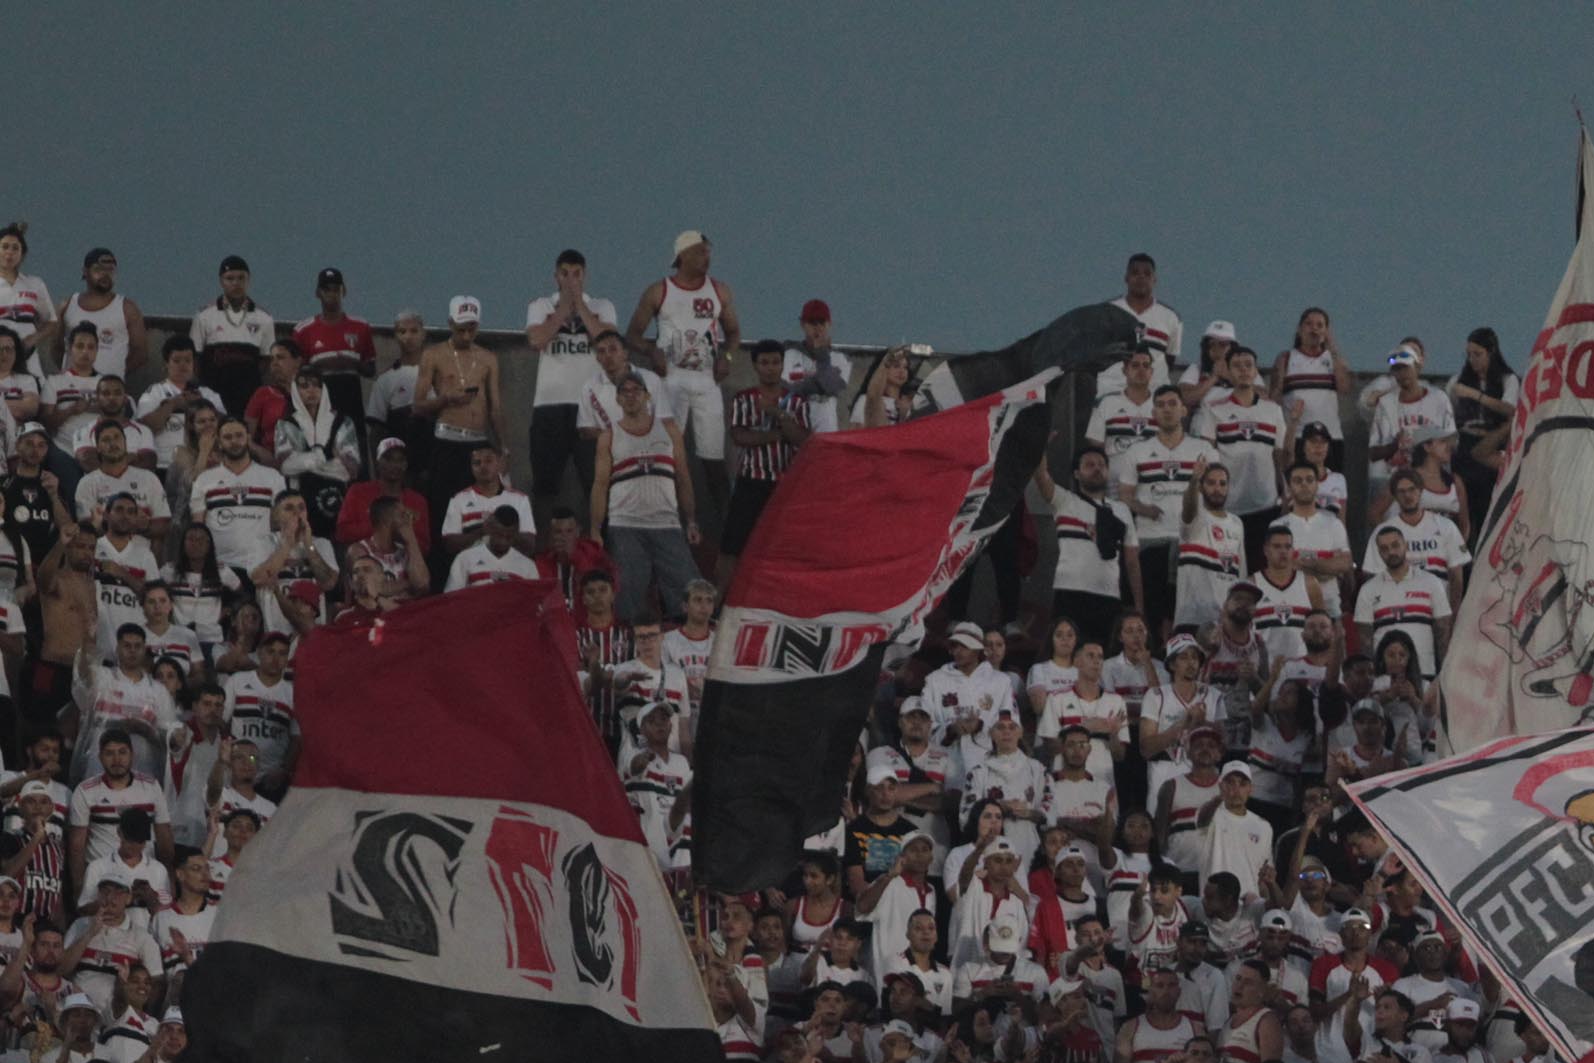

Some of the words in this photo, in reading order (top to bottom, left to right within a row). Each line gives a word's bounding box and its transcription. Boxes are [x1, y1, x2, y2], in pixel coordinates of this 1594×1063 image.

[32, 509, 48, 520] LG
[101, 587, 137, 608] nter
[734, 622, 893, 673] IND
[26, 874, 61, 893] inter
